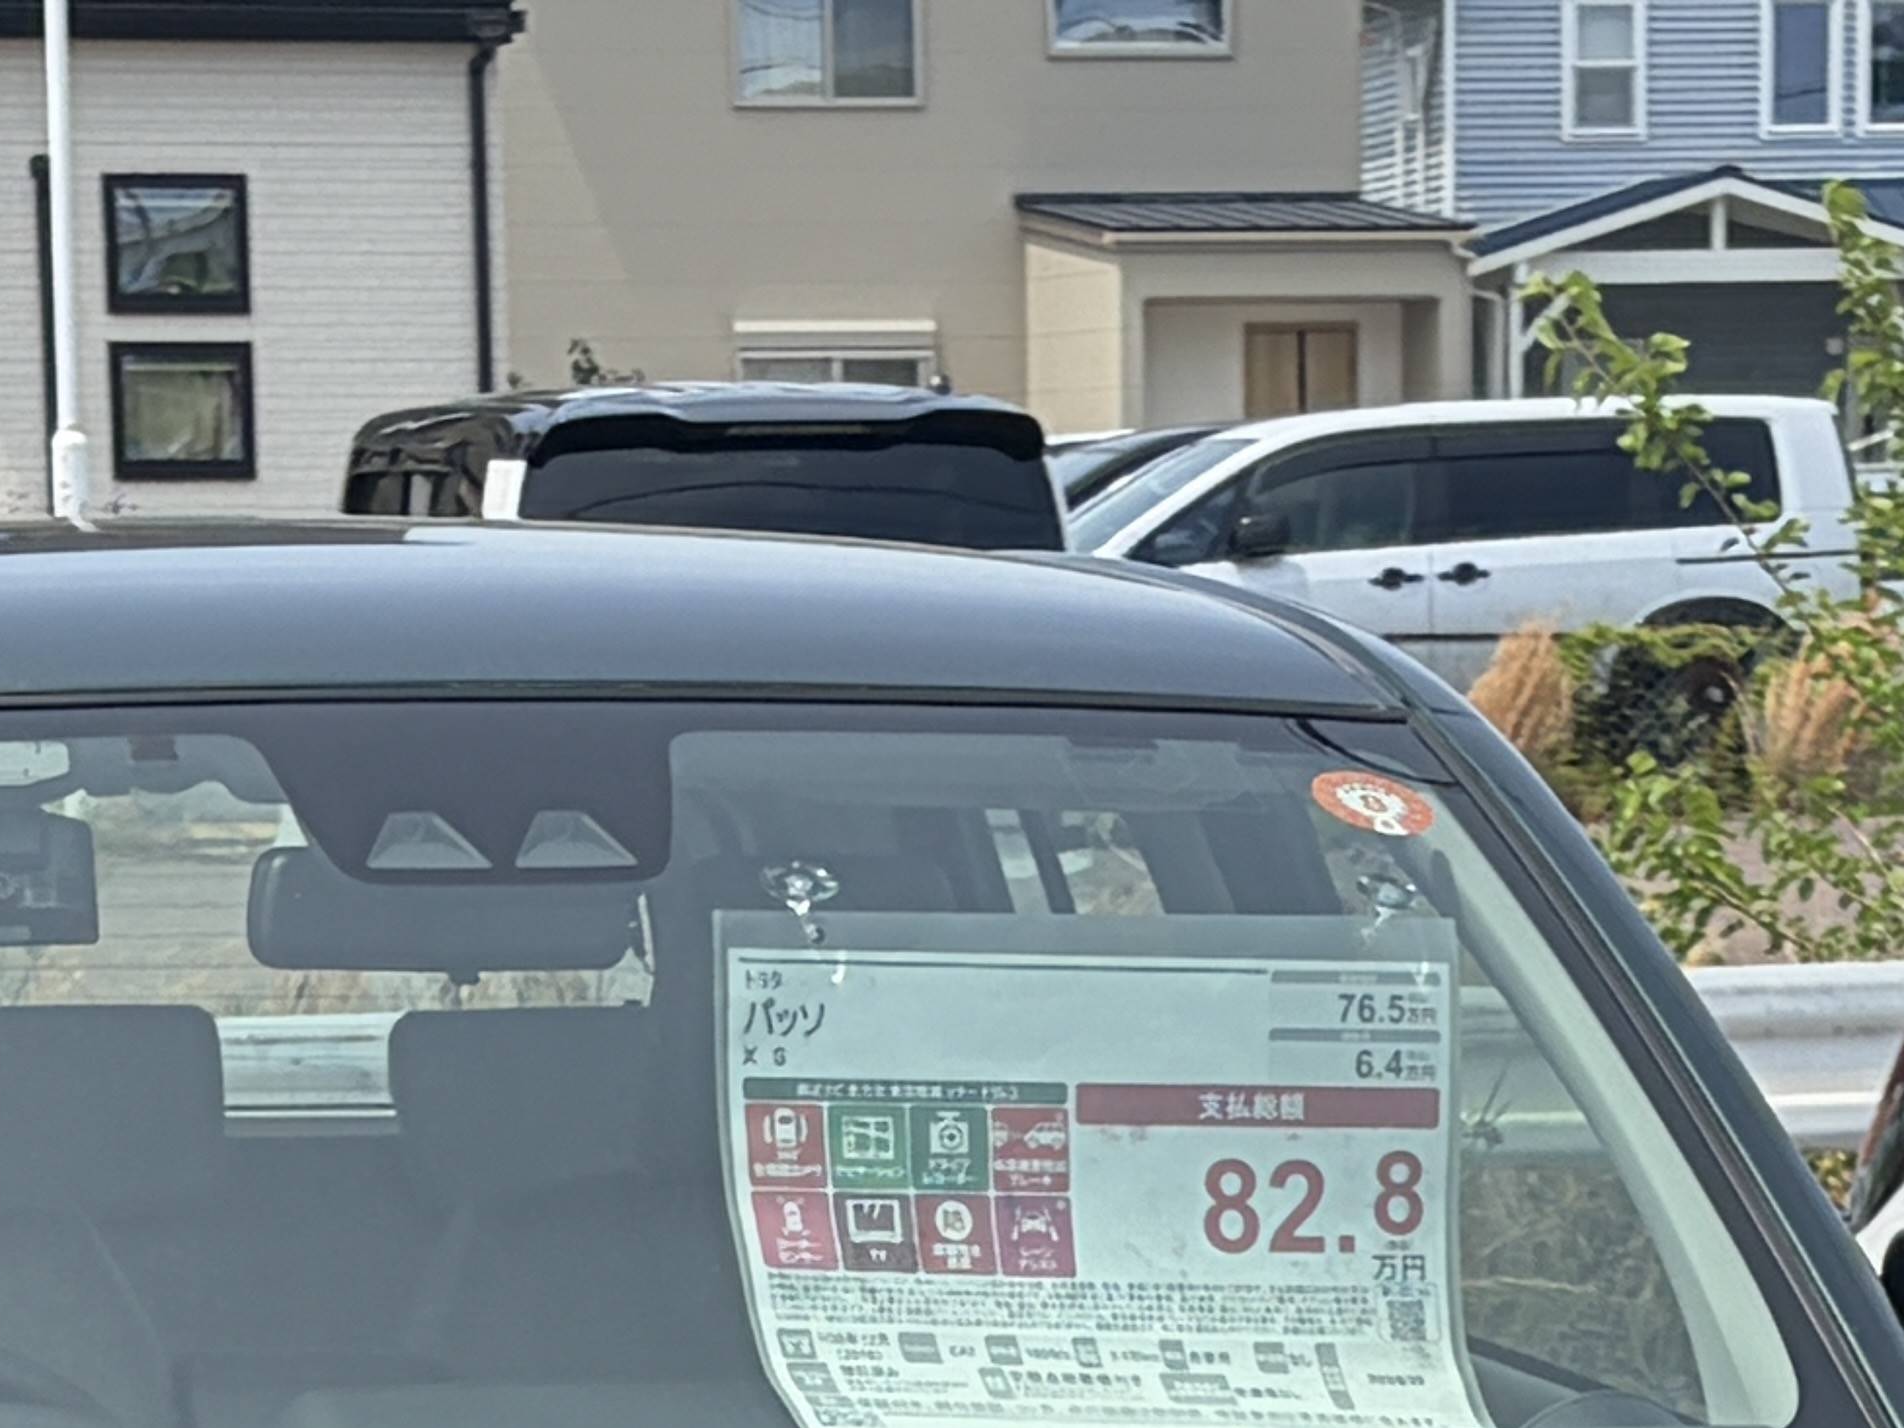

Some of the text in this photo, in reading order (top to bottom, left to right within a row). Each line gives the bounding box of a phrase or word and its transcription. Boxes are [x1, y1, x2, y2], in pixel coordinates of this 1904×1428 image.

[743, 996, 826, 1037] パッソ
[1337, 993, 1405, 1024] 76.5
[742, 1046, 758, 1066] X
[1354, 1049, 1404, 1080] 6.4
[1196, 1092, 1306, 1121] 支払総額
[1202, 1149, 1425, 1255] 82.8
[1371, 1254, 1427, 1282] 万円
